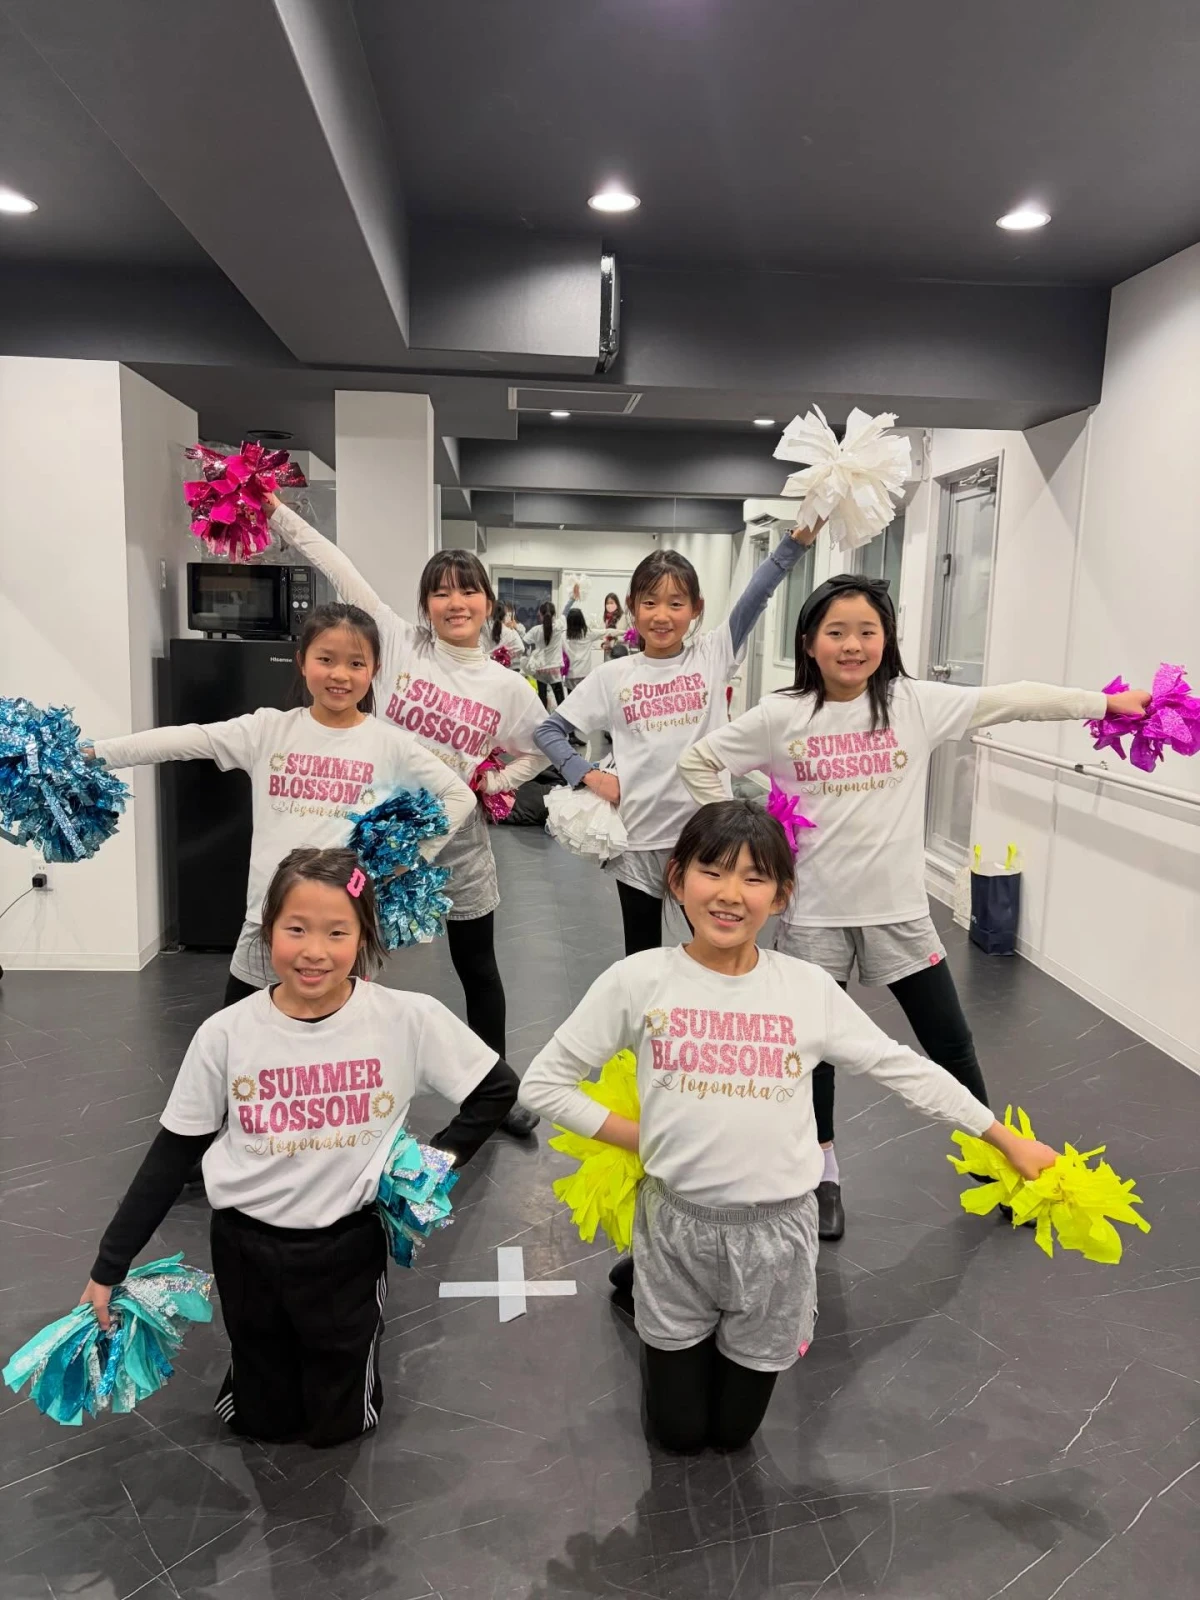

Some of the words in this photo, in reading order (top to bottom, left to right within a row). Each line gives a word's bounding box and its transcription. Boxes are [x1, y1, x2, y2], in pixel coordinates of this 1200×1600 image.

[633, 673, 705, 701] SUMMER
[405, 679, 501, 736] SUMMER
[623, 692, 703, 725] BLOSSOM
[385, 693, 487, 757] BLOSSOM
[807, 728, 899, 758] SUMMER
[285, 753, 374, 784] SUMMER
[793, 752, 892, 782] BLOSSOM
[269, 774, 362, 805] BLOSSOM
[820, 777, 885, 797] Toyonaka
[669, 1007, 796, 1046] SUMMER
[651, 1039, 784, 1079] BLOSSOM
[258, 1058, 384, 1100] SUMMER
[679, 1073, 773, 1100] Toyonaka
[238, 1092, 371, 1134] BLOSSOM
[265, 1131, 358, 1158] Toyonaka
